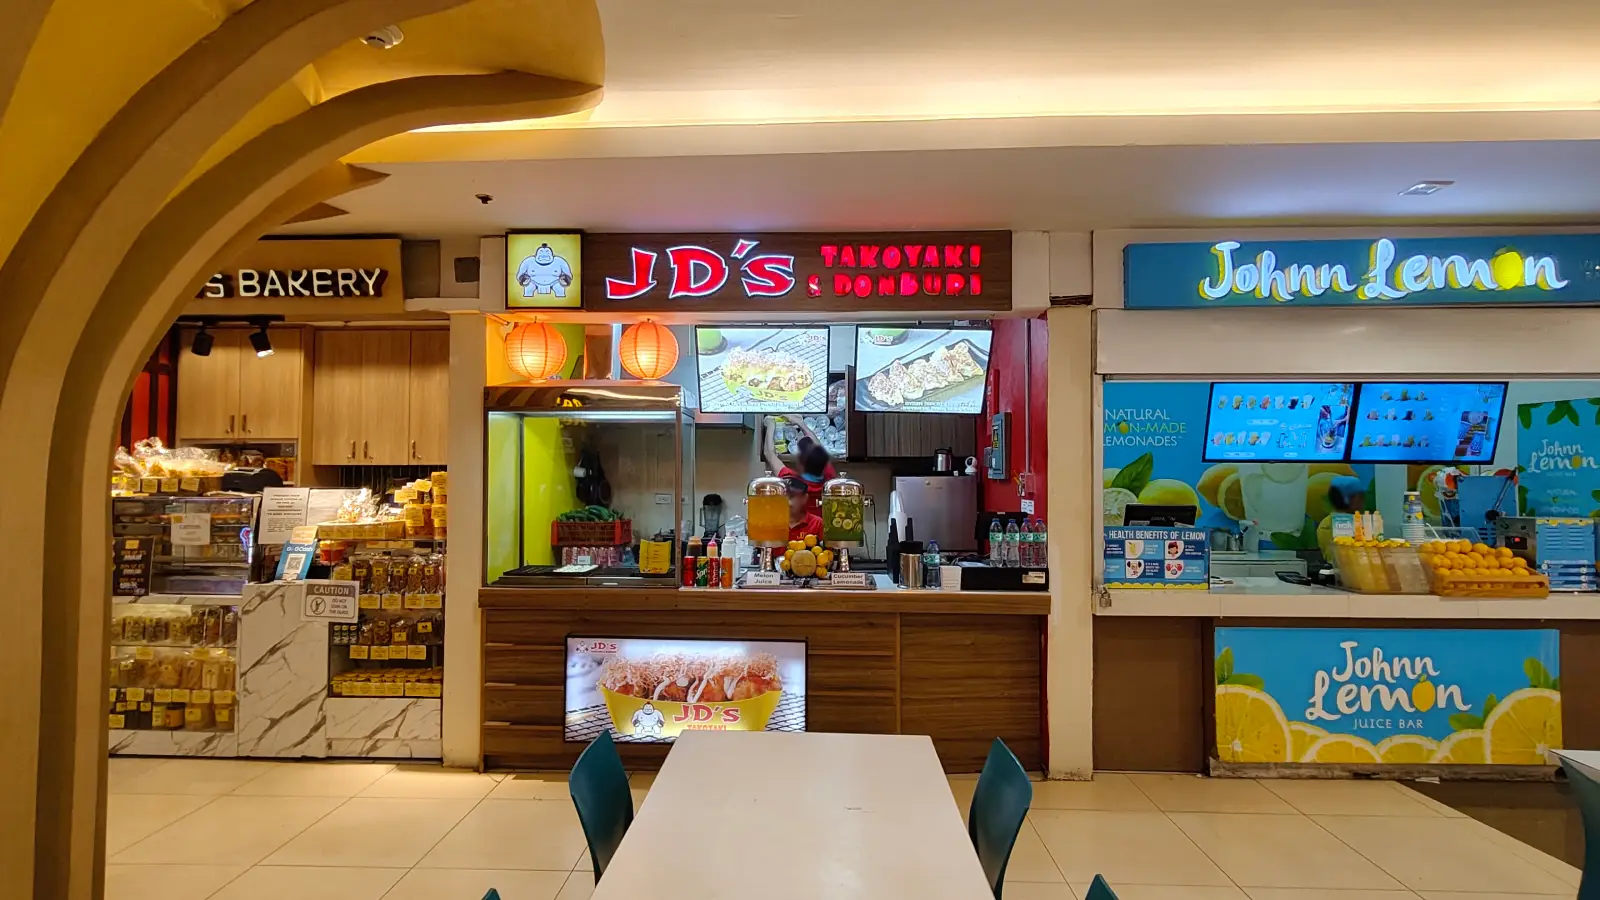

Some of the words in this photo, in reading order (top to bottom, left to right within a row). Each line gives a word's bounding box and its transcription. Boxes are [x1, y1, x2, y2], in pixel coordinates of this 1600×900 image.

[820, 245, 982, 268] TAKOYAKI
[606, 239, 796, 298] JD'S
[1202, 241, 1357, 301] Johnn
[1359, 238, 1569, 301] Lemon
[238, 268, 381, 297] BAKERY
[833, 272, 983, 297] DONBURI
[1104, 408, 1171, 421] NATURAL
[1538, 438, 1584, 457] Johnn
[1528, 451, 1600, 473] Lemon
[1109, 530, 1134, 539] HEALTH
[1135, 530, 1168, 540] BENEFITS
[1170, 531, 1180, 540] OF
[1181, 532, 1206, 541] LEMON
[313, 585, 350, 596] CAUTION
[591, 642, 617, 650] JD'S
[1331, 640, 1440, 683] Johnn
[1304, 670, 1472, 722] Lemon
[672, 703, 741, 724] JD'S
[1353, 718, 1393, 730] JUICE
[1398, 718, 1424, 729] BAR
